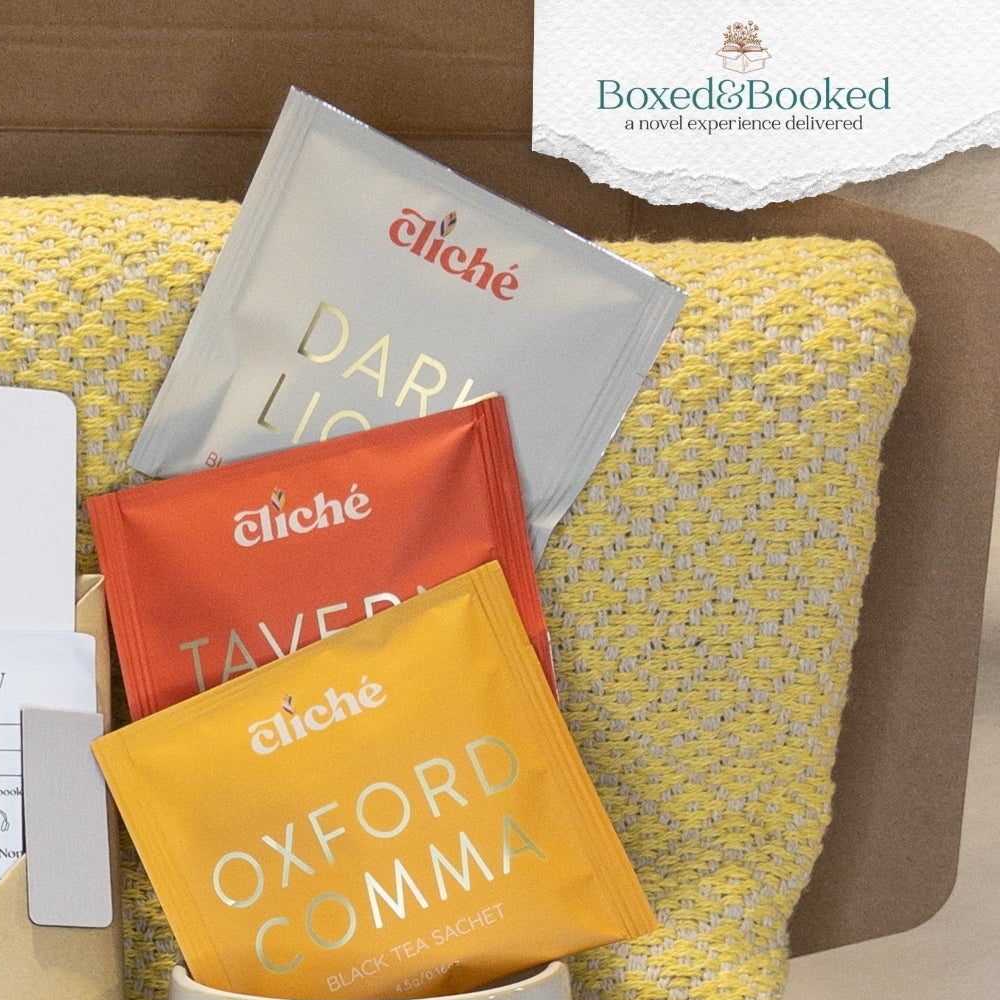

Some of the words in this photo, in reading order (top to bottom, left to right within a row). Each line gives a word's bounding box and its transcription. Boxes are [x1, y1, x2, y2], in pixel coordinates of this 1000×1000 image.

[388, 207, 520, 302] cliché
[233, 483, 373, 548] cliché
[250, 674, 388, 756] cliché
[212, 736, 520, 909] OXFORD
[253, 814, 547, 975] COMMA
[326, 953, 390, 993] BLACK
[391, 937, 430, 963] TEA
[431, 903, 506, 946] SACHET
